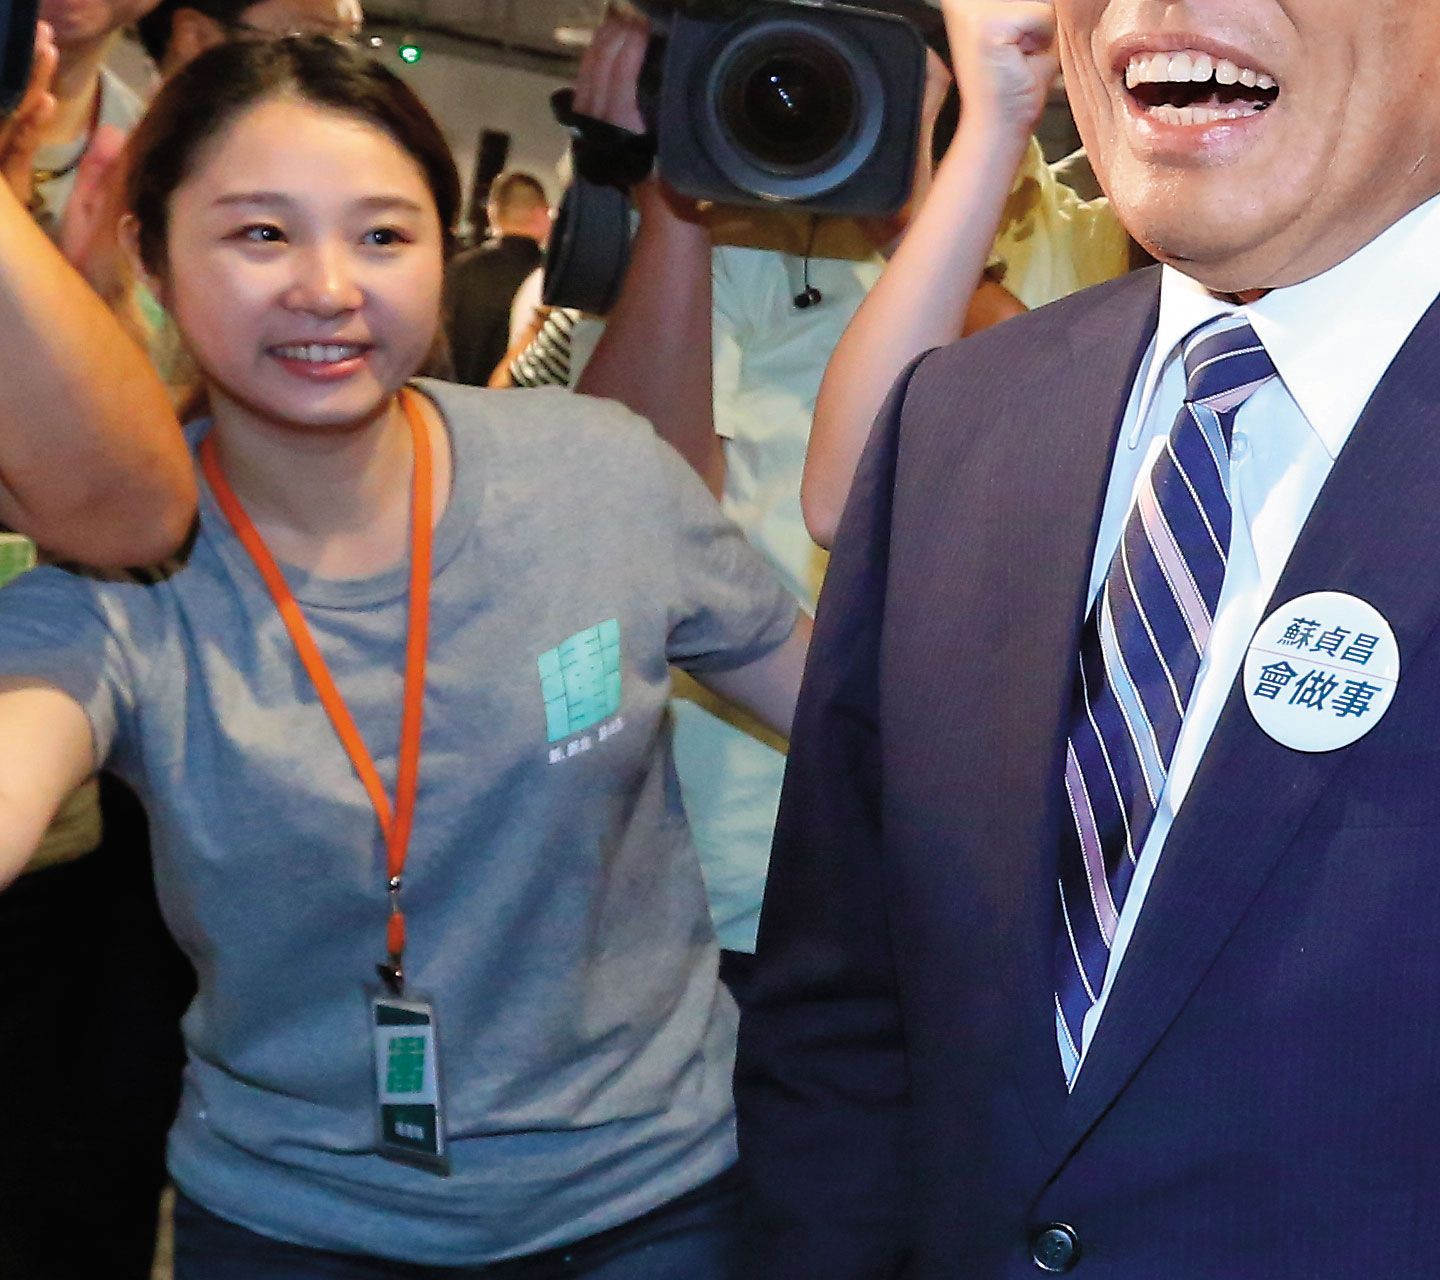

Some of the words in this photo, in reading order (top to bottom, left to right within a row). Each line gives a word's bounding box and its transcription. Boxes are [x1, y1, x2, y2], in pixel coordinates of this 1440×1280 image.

[1277, 618, 1380, 666] 蘇貞昌
[1253, 661, 1382, 718] 會做事
